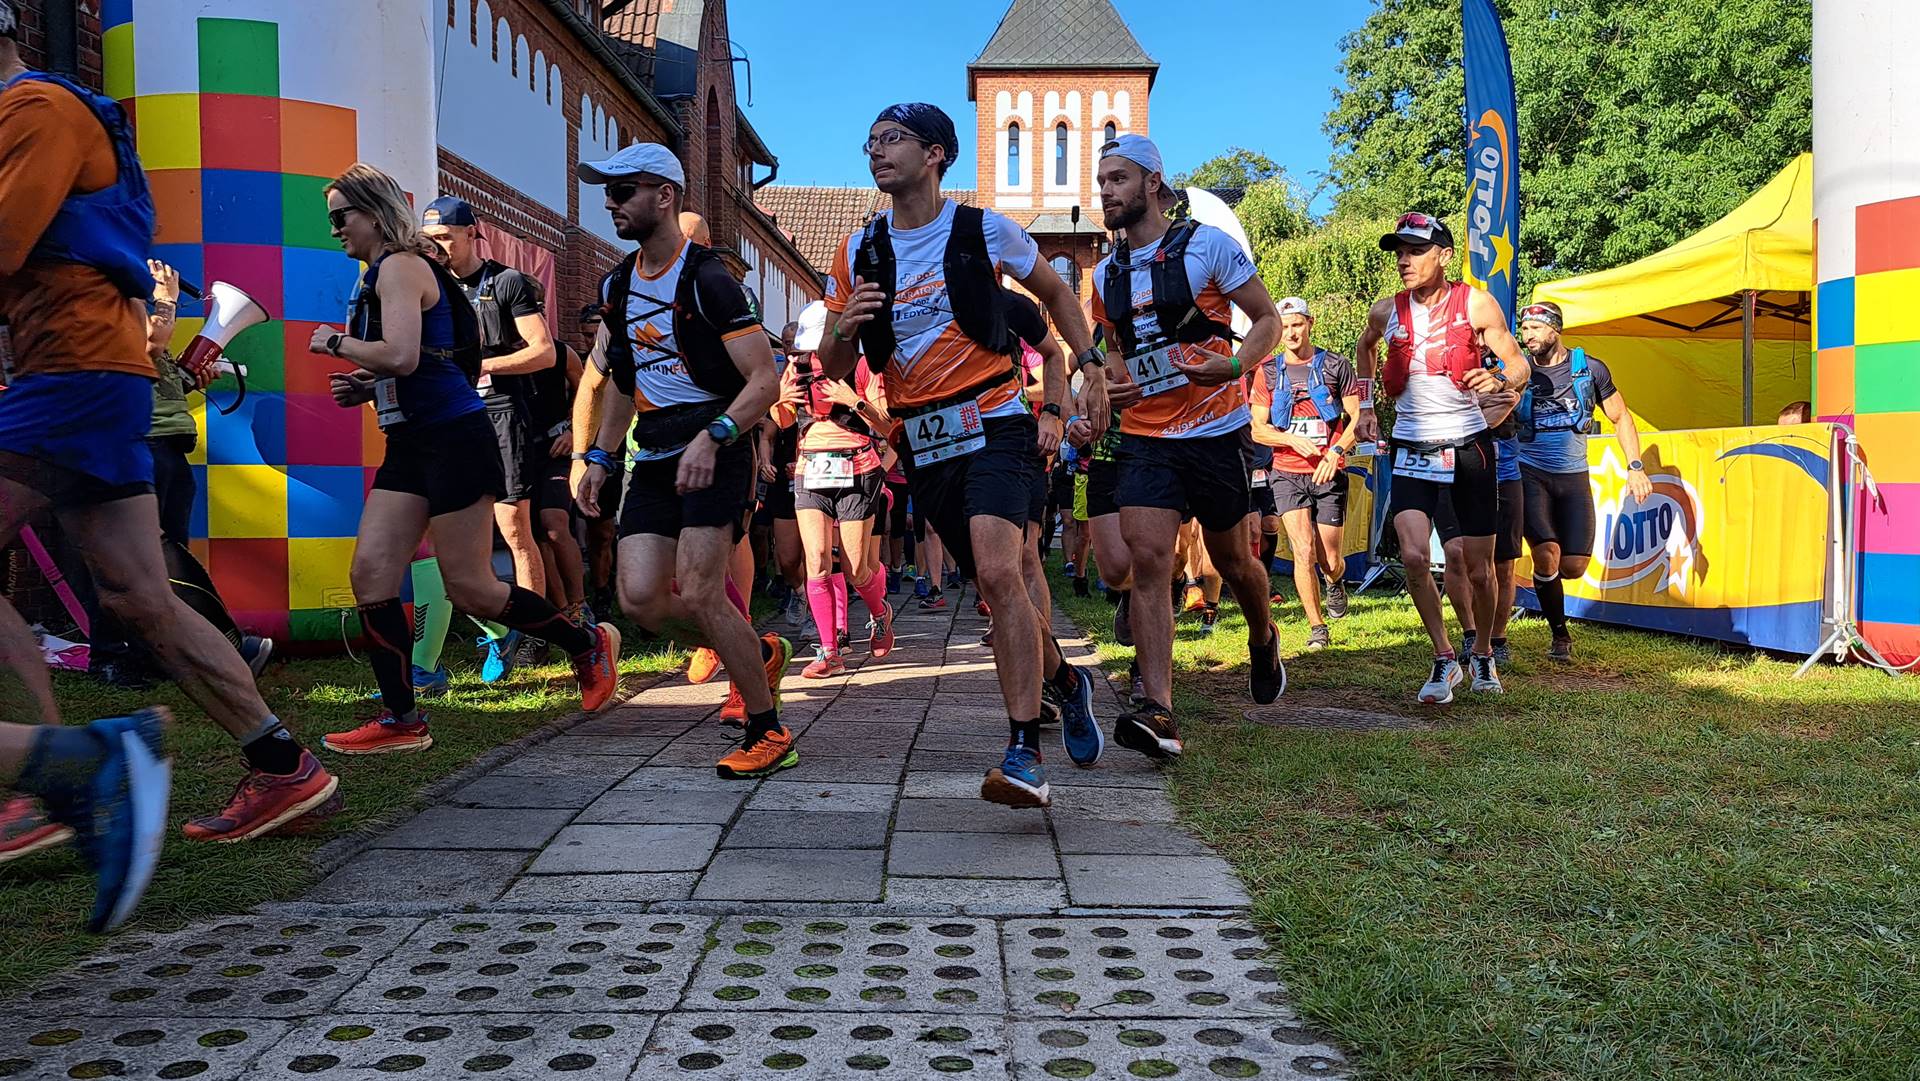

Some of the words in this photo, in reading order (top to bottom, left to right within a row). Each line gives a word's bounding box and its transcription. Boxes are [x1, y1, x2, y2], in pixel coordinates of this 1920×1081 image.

[1137, 355, 1160, 378] 41
[918, 415, 949, 442] 42
[1196, 410, 1215, 425] KM
[1290, 422, 1308, 435] 74
[1604, 502, 1673, 560] LOTTO
